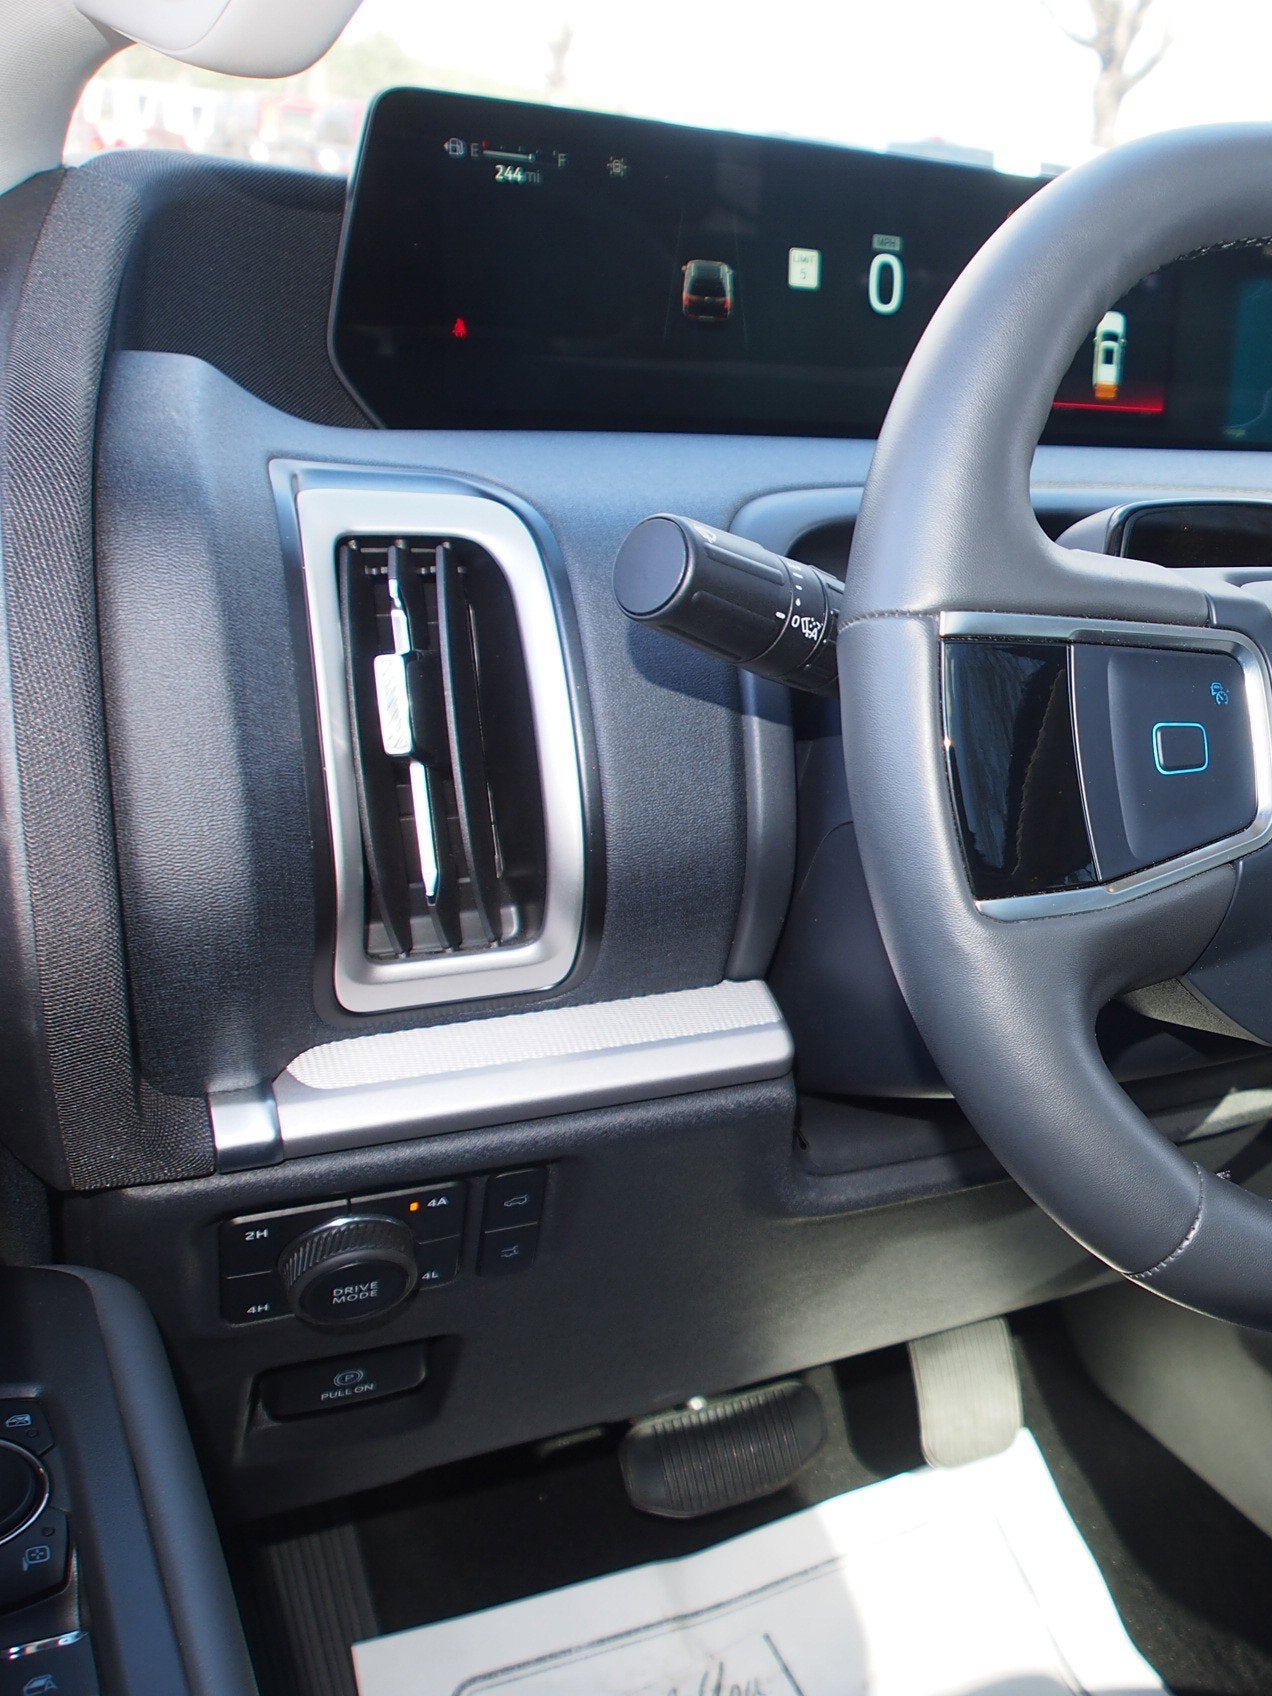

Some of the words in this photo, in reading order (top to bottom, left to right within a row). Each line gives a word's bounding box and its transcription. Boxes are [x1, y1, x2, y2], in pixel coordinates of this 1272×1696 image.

[470, 143, 479, 158] E
[557, 152, 567, 169] F
[495, 164, 524, 182] 244
[868, 252, 902, 315] 0
[426, 1196, 449, 1208] 4A
[244, 1228, 270, 1242] 2H
[421, 1270, 440, 1281] 4L
[333, 1281, 380, 1298] DRIVE
[332, 1290, 379, 1305] MODE
[246, 1303, 270, 1315] 4H
[320, 1389, 352, 1401] PULL
[354, 1383, 375, 1396] ON
